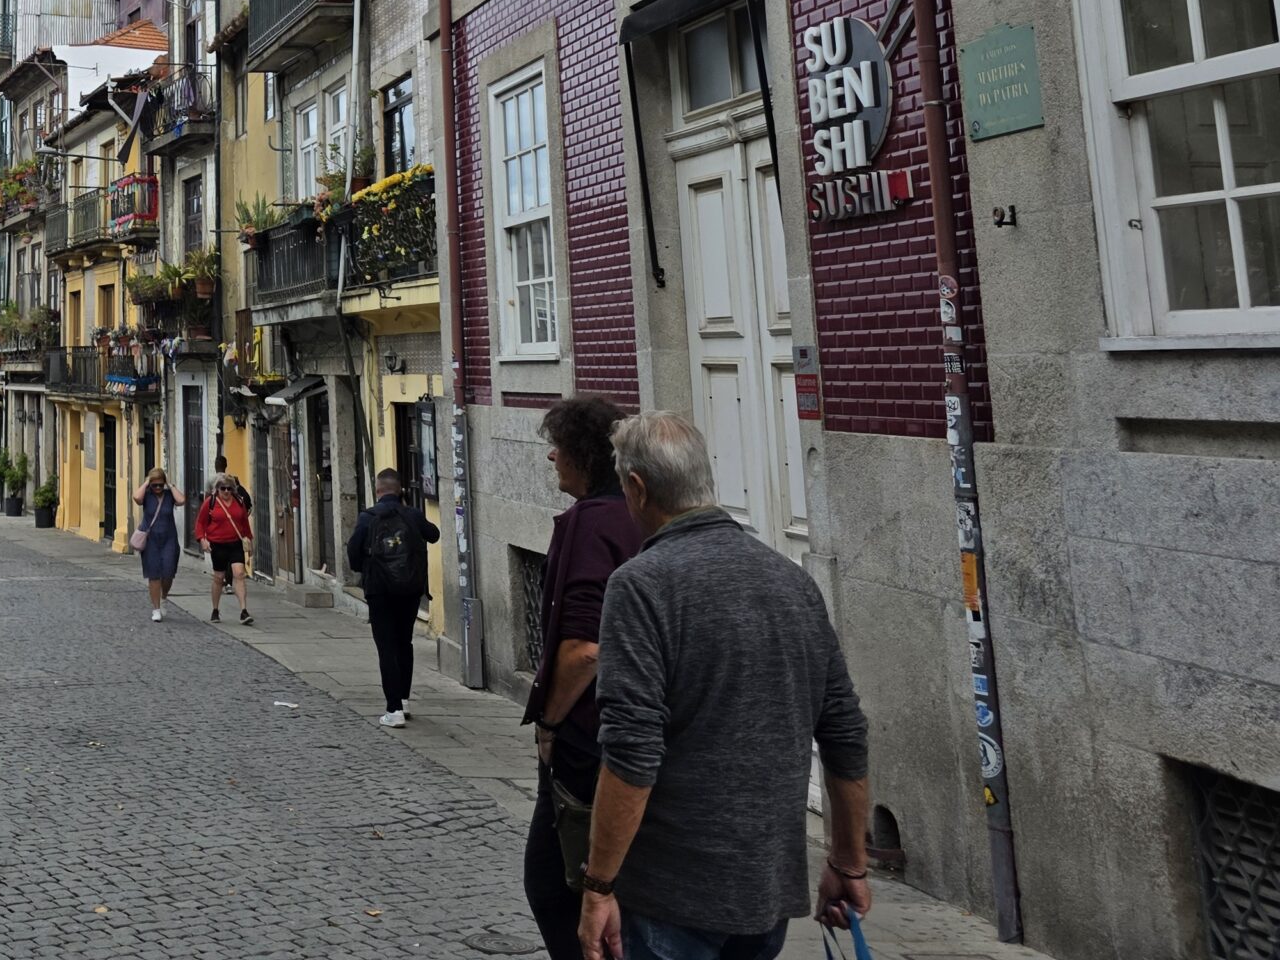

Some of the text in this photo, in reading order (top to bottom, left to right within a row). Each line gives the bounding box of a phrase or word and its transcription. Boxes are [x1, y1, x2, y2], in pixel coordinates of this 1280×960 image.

[804, 17, 847, 72] SU
[808, 61, 875, 123] BEN
[814, 120, 866, 176] SHI
[810, 170, 893, 220] SUSHI
